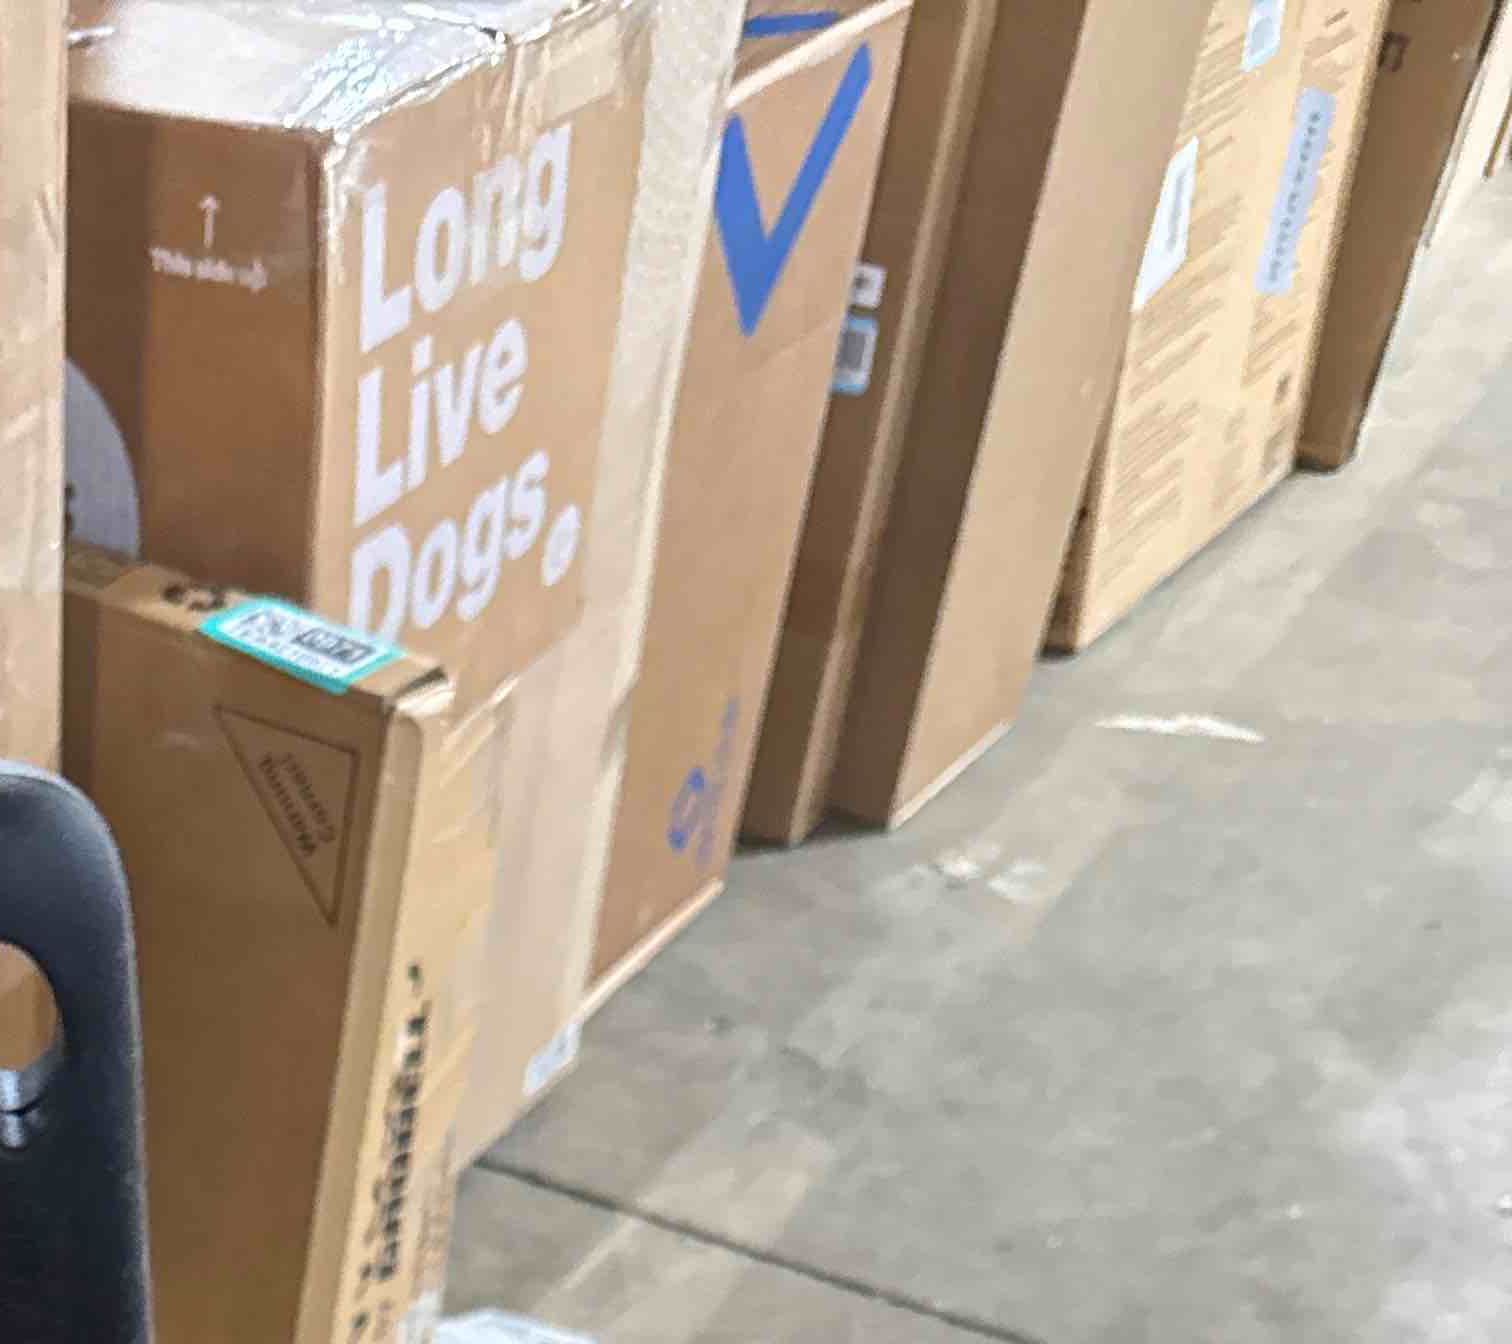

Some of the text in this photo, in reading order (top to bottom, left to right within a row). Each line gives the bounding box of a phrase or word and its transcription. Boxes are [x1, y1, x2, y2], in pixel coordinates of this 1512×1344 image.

[359, 123, 573, 355] Long
[354, 316, 529, 528] Live
[348, 450, 581, 645] Dogs.
